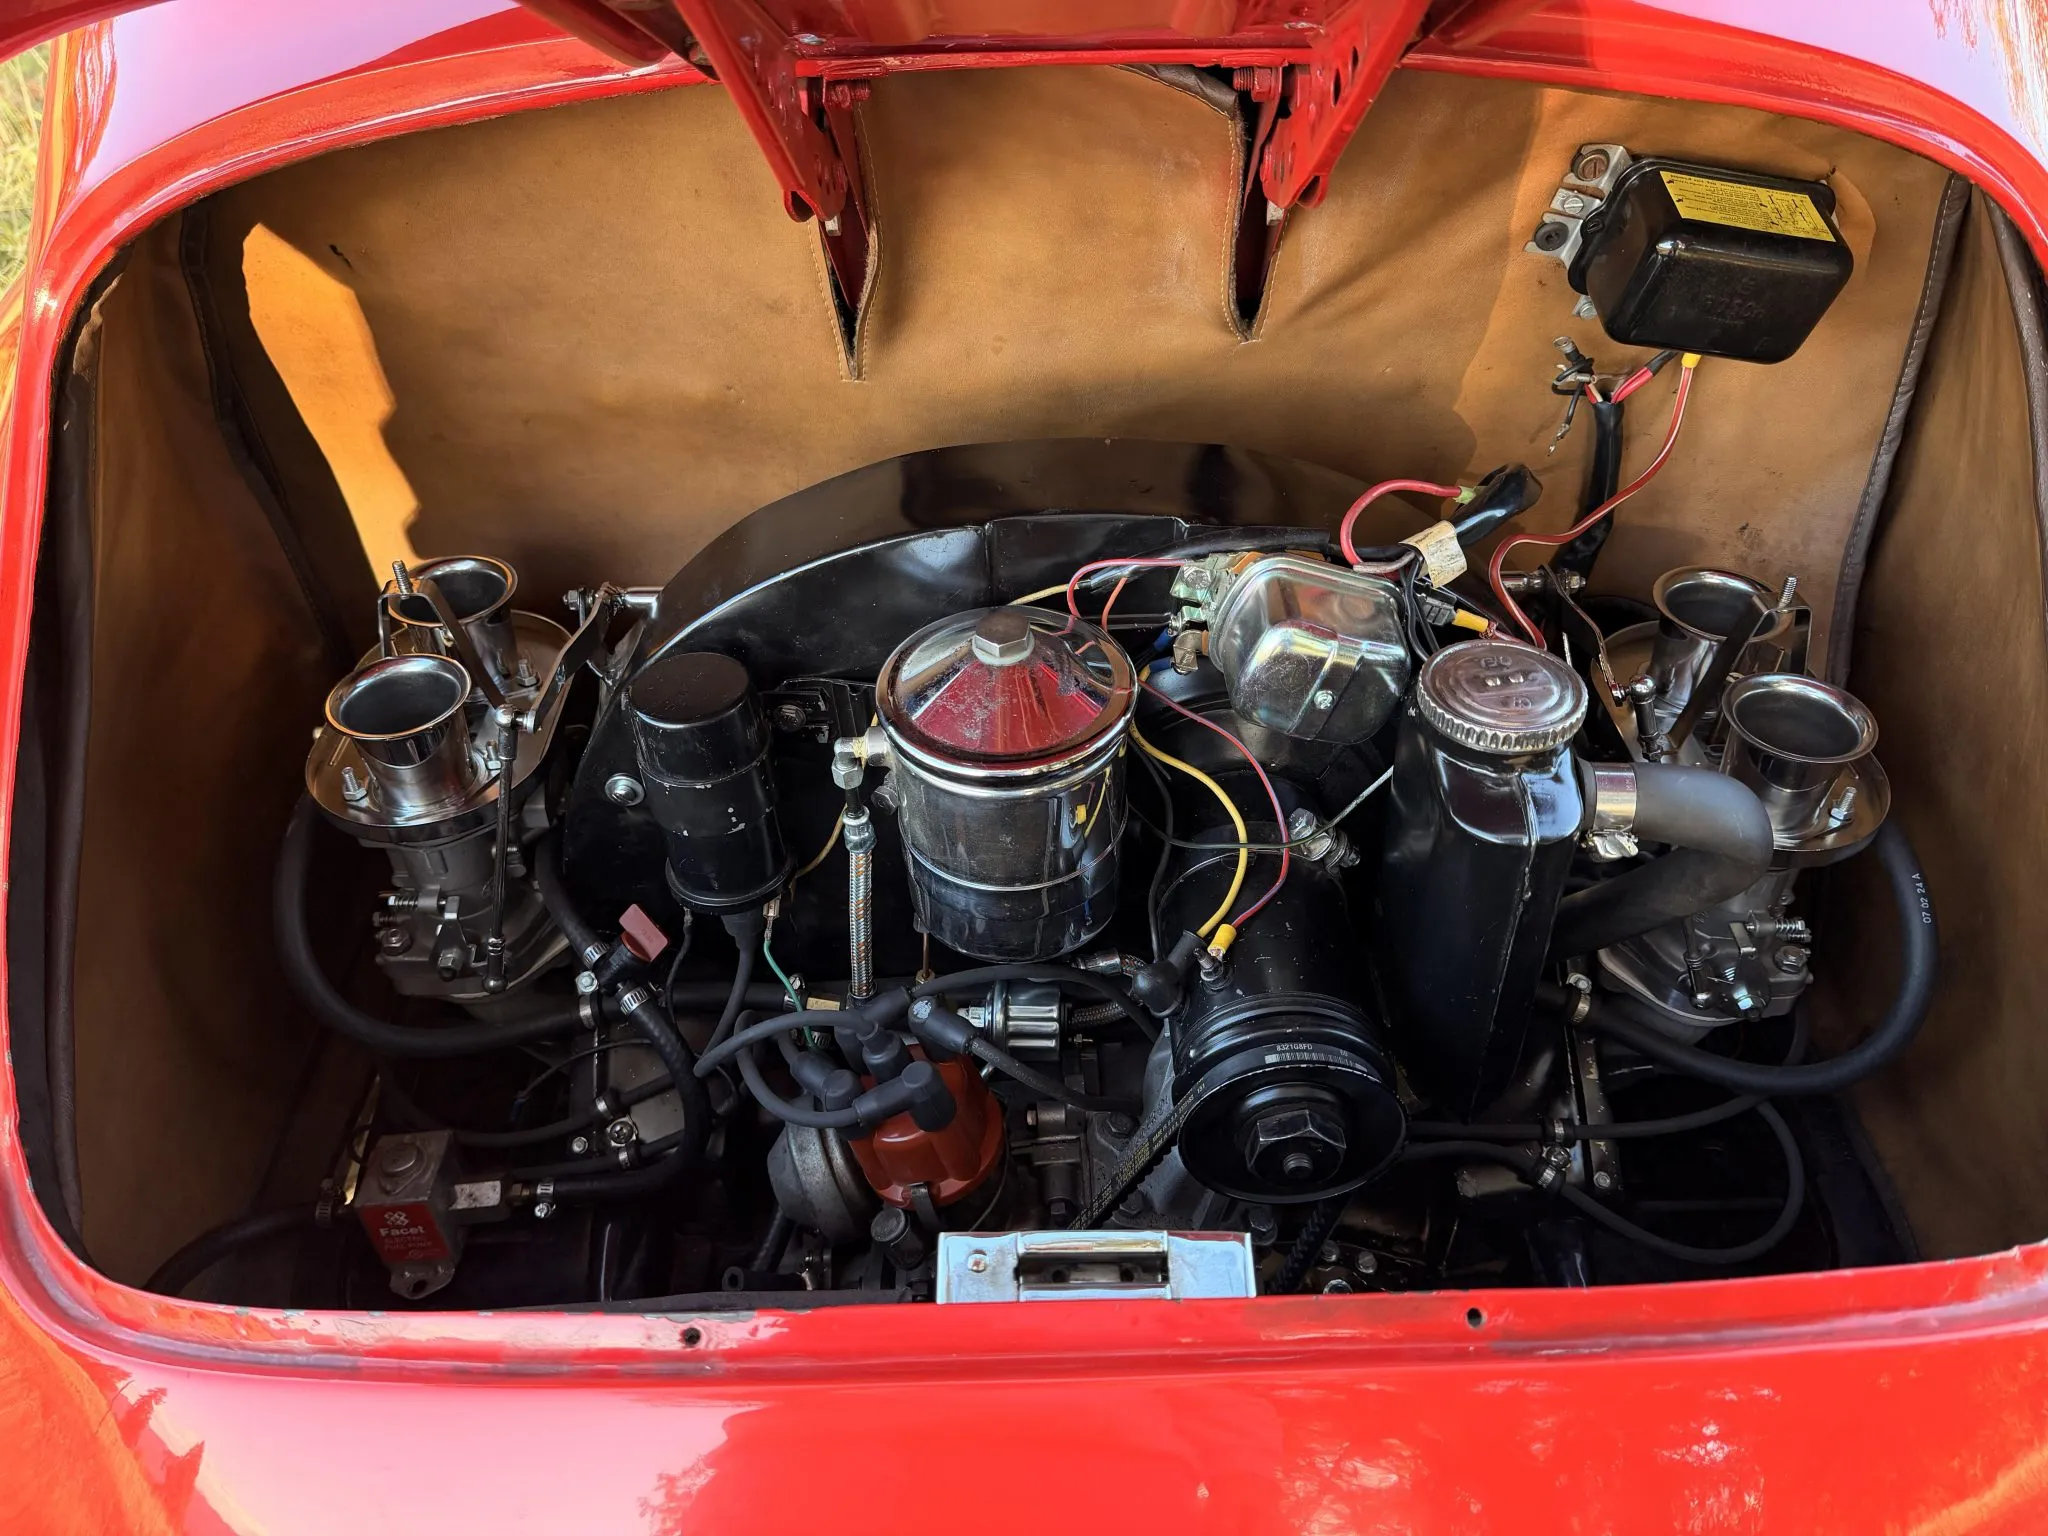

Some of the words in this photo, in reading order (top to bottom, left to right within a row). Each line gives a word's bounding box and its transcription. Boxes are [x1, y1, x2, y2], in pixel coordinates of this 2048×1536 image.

[1915, 882, 1926, 894] 24
[1920, 897, 1930, 909] 02
[1922, 911, 1932, 924] 07
[379, 1225, 425, 1237] Facet
